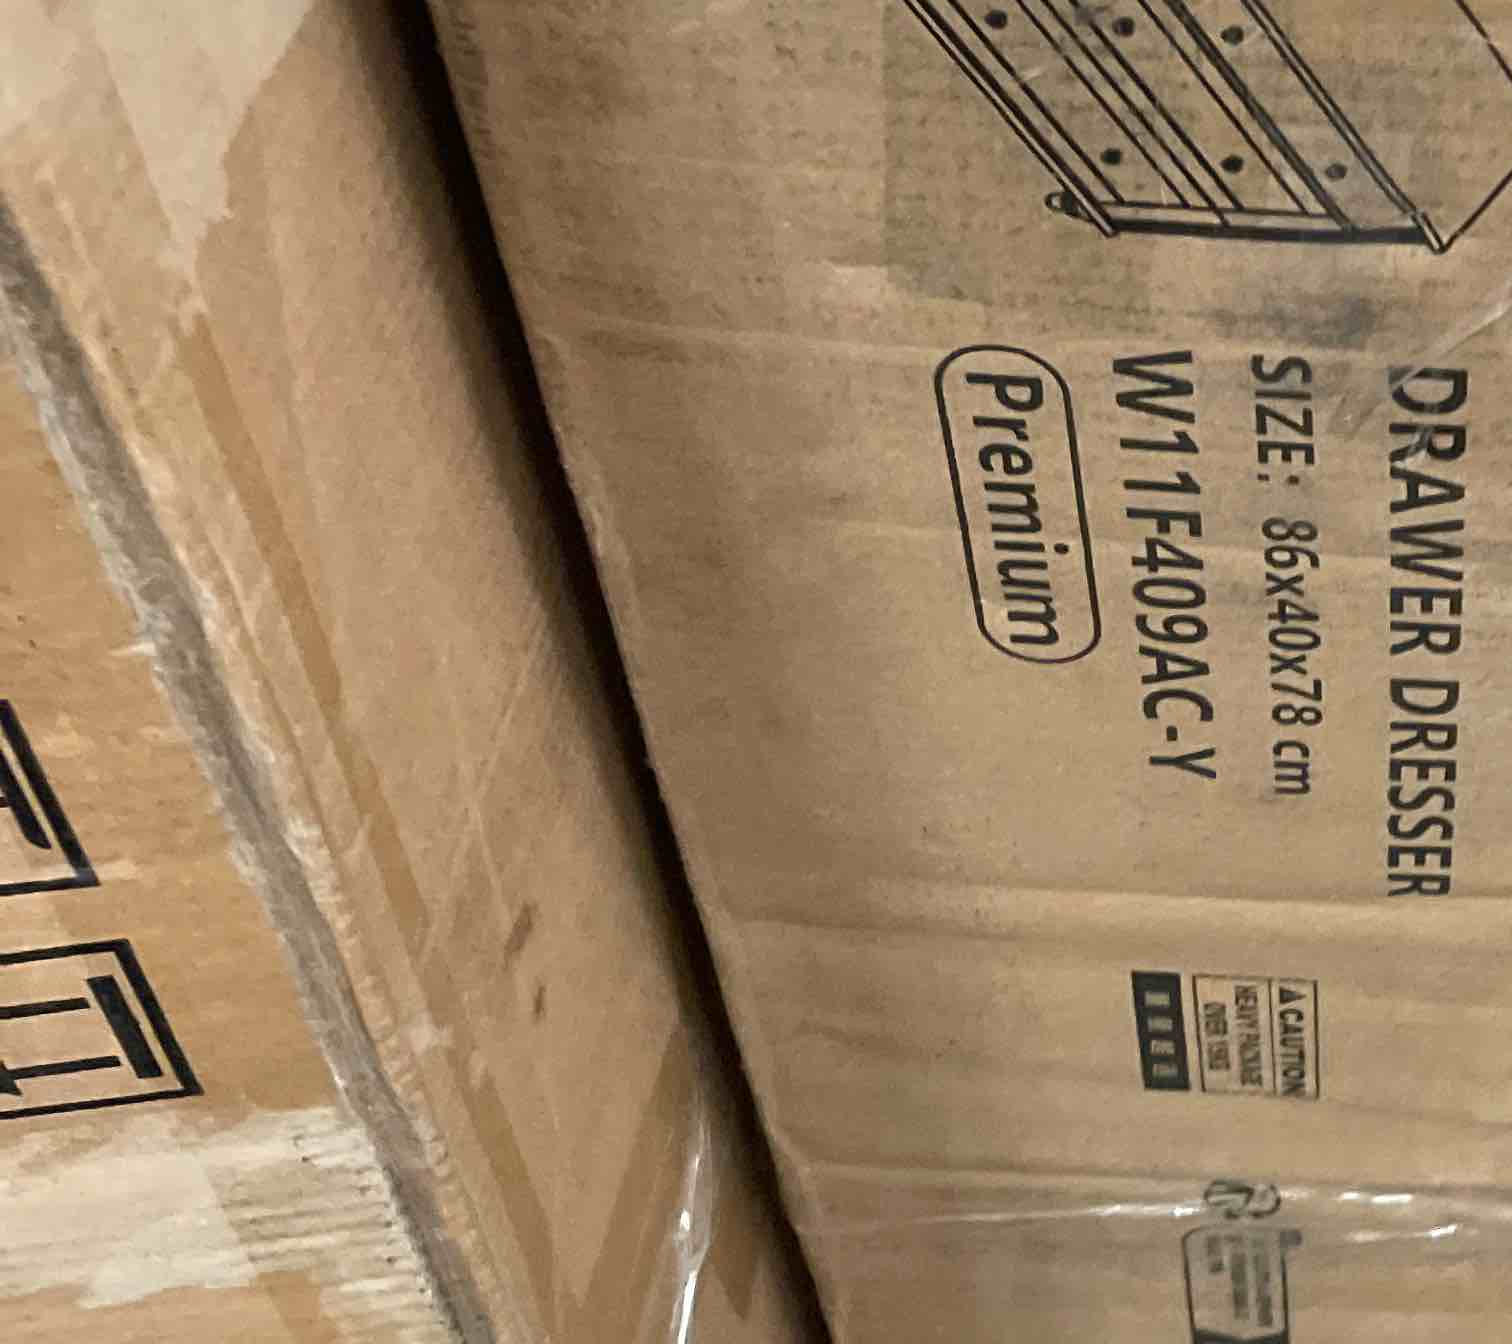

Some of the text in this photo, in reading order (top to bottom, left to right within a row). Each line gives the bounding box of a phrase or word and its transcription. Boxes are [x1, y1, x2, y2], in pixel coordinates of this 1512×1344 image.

[964, 372, 1069, 647] Premium
[1112, 351, 1217, 779] W11F409AC-Y
[1251, 354, 1323, 795] SIZE: 86x40x78 cm
[1386, 367, 1469, 897] DRAWER DRESSER
[1279, 1008, 1306, 1096] CAUTION
